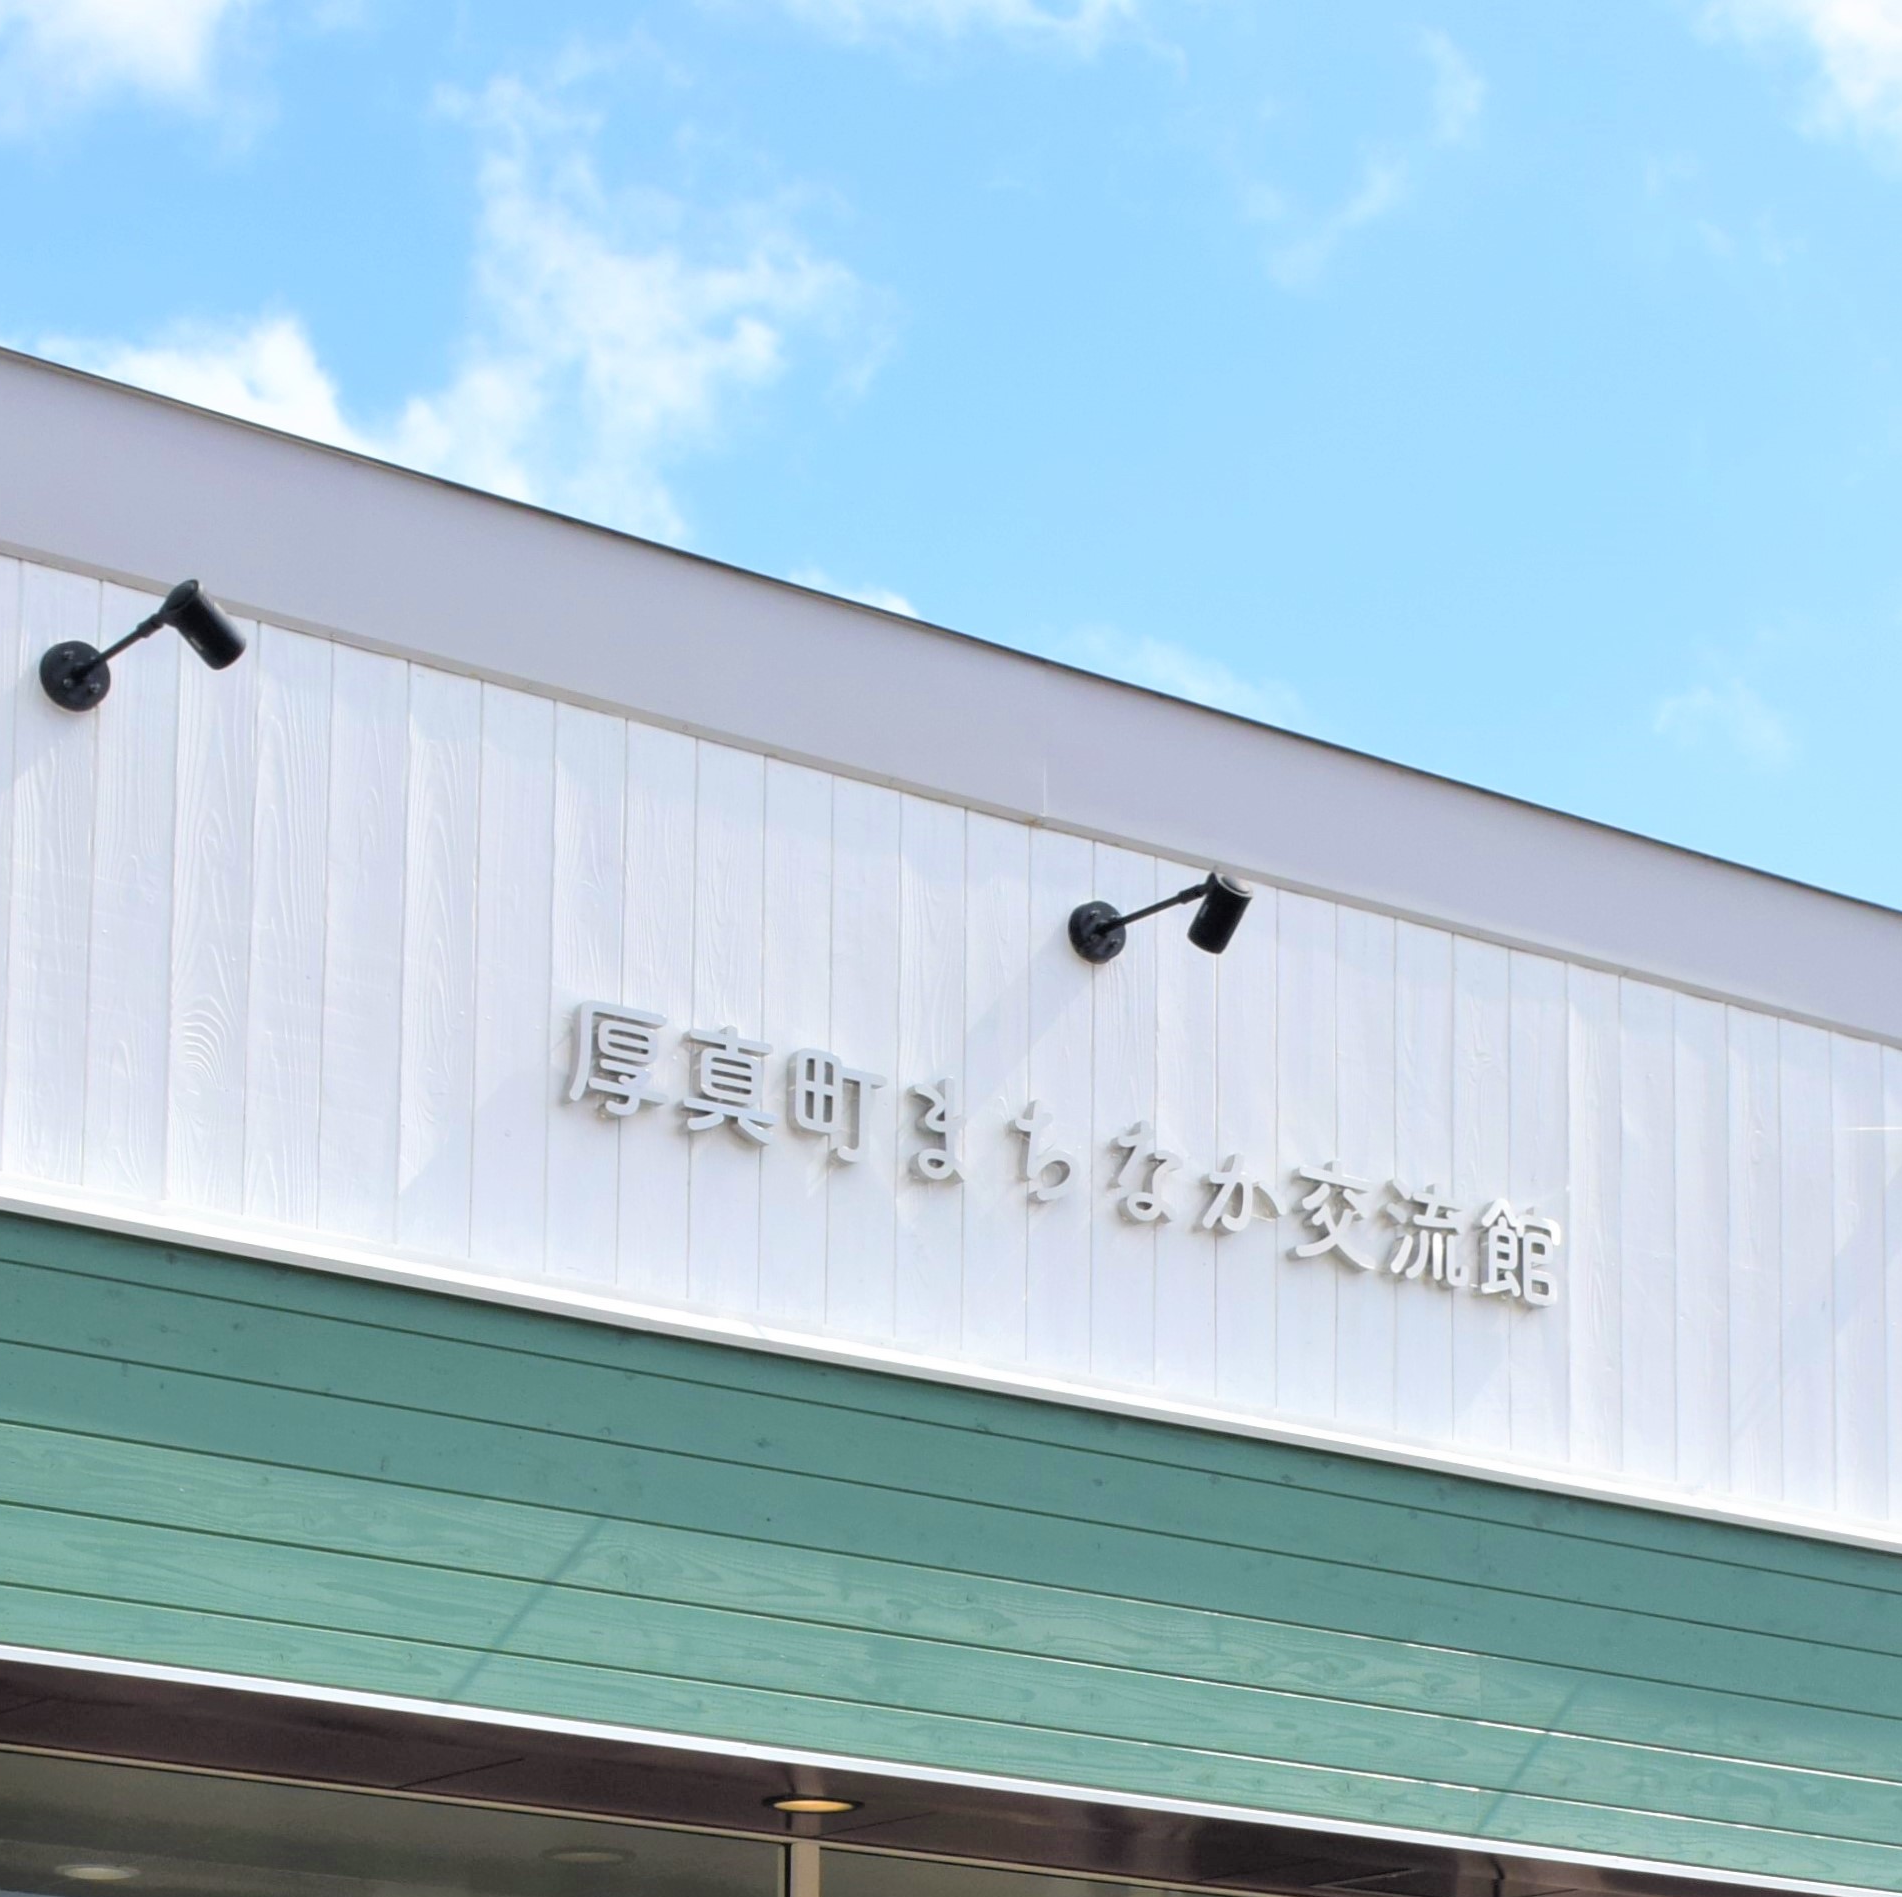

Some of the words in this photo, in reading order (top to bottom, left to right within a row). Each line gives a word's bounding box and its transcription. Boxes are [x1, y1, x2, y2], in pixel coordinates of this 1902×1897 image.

[567, 998, 1565, 1310] 厚真町まちなか交流館
